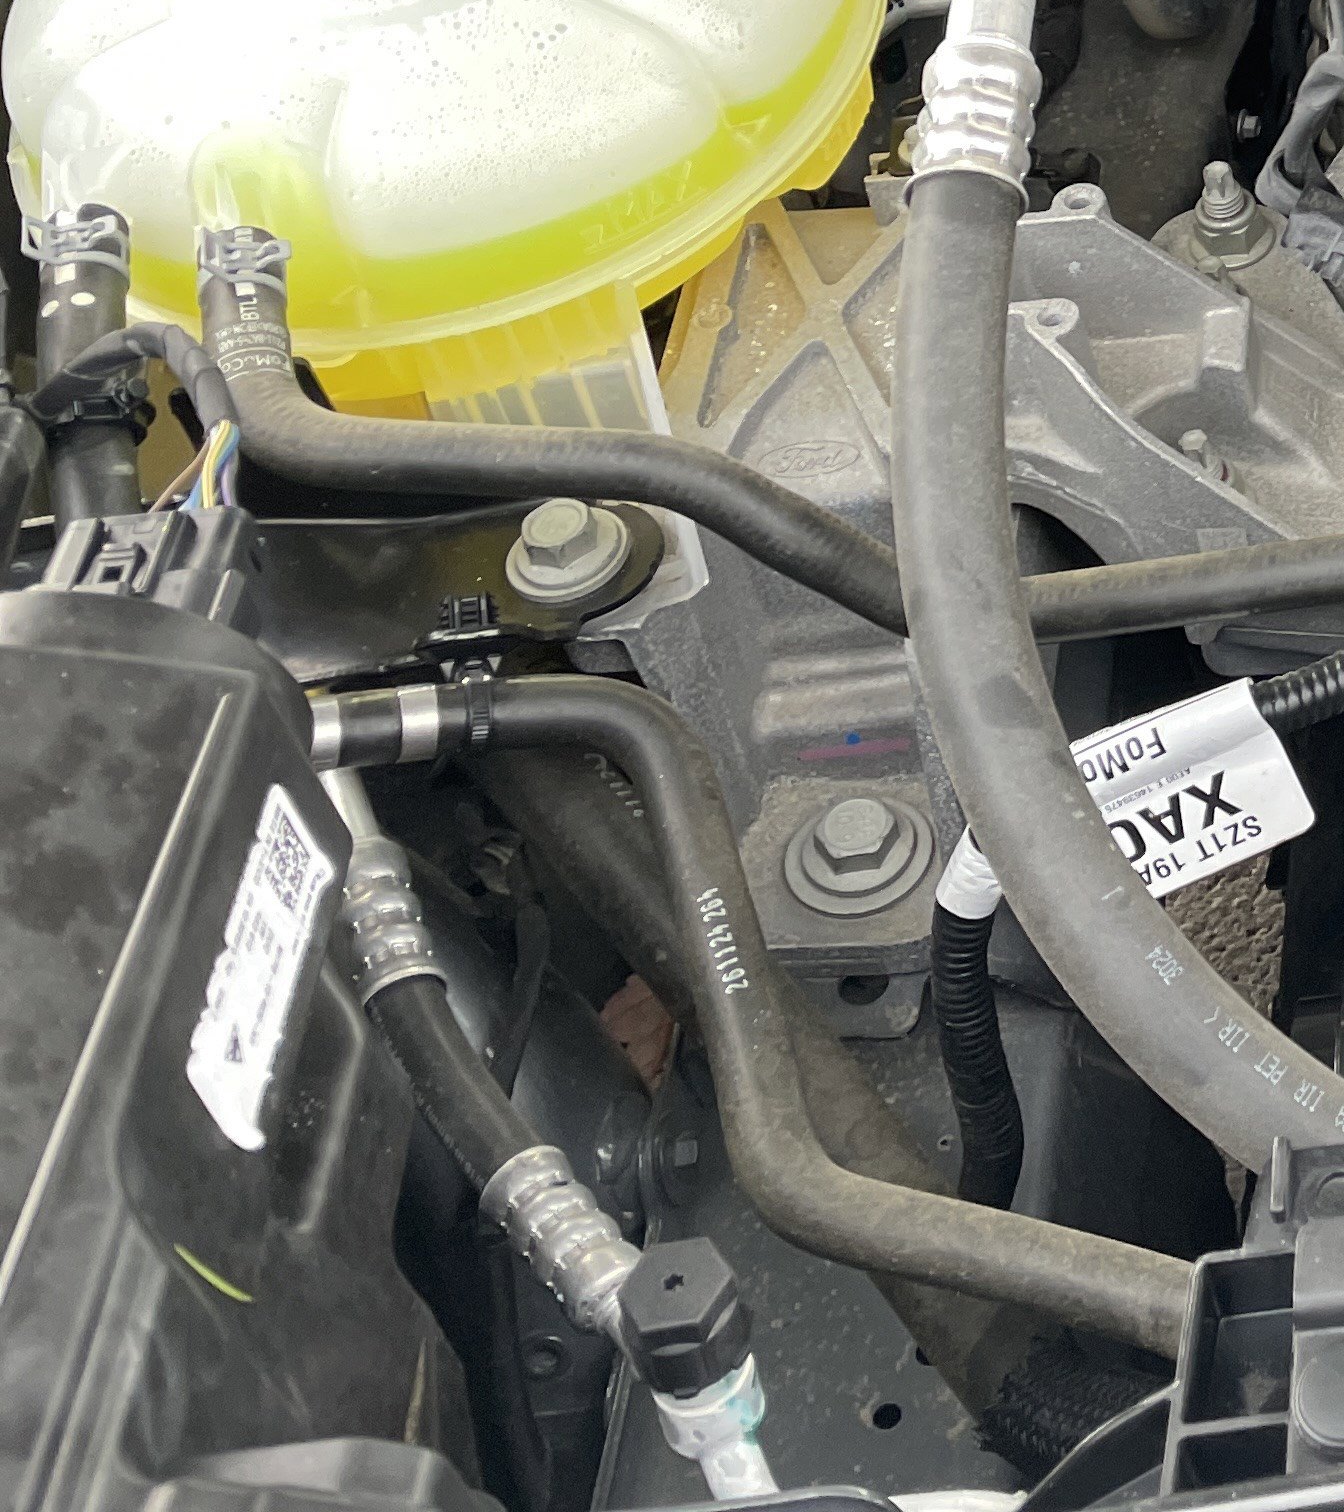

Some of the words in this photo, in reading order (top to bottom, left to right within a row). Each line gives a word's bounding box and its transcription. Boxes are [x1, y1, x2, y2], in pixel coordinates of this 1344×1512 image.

[774, 445, 845, 475] Ford
[1196, 815, 1263, 863] SZ1T
[1253, 1050, 1290, 1087] PET
